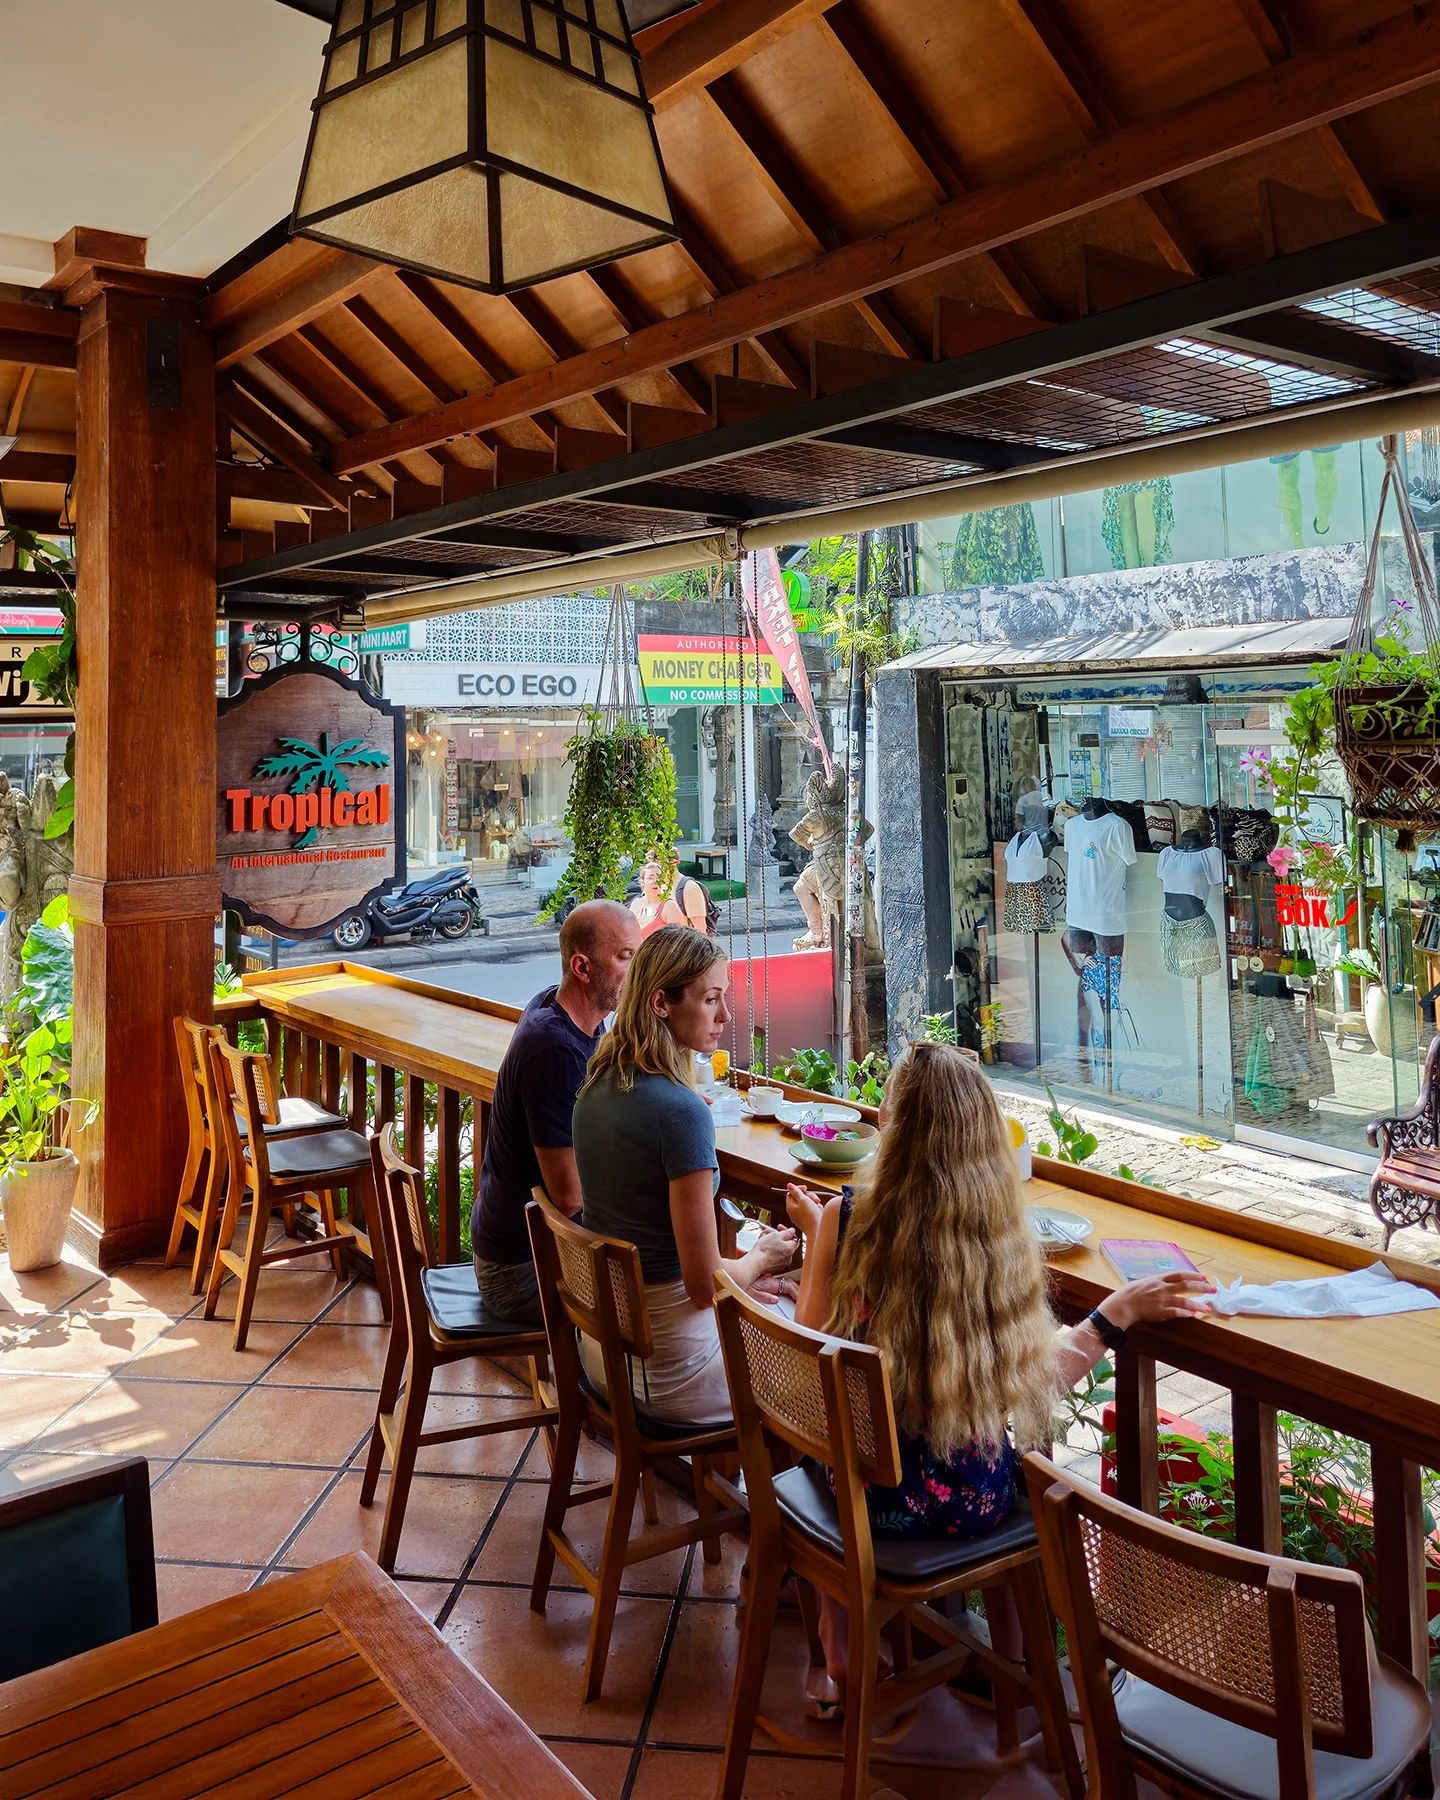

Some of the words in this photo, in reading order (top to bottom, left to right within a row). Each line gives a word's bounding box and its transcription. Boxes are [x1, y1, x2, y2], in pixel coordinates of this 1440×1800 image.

[360, 633, 382, 649] MINI
[382, 629, 408, 645] MART
[677, 640, 749, 650] AUTHORIZED
[653, 660, 704, 679] MONEY
[458, 673, 515, 696] ECO
[522, 674, 577, 697] EGO
[670, 690, 687, 700] NO
[226, 784, 391, 833] Tropical
[230, 856, 247, 869] An
[248, 852, 325, 868] International
[327, 847, 388, 862] Restaurant
[1276, 896, 1331, 929] 50K
